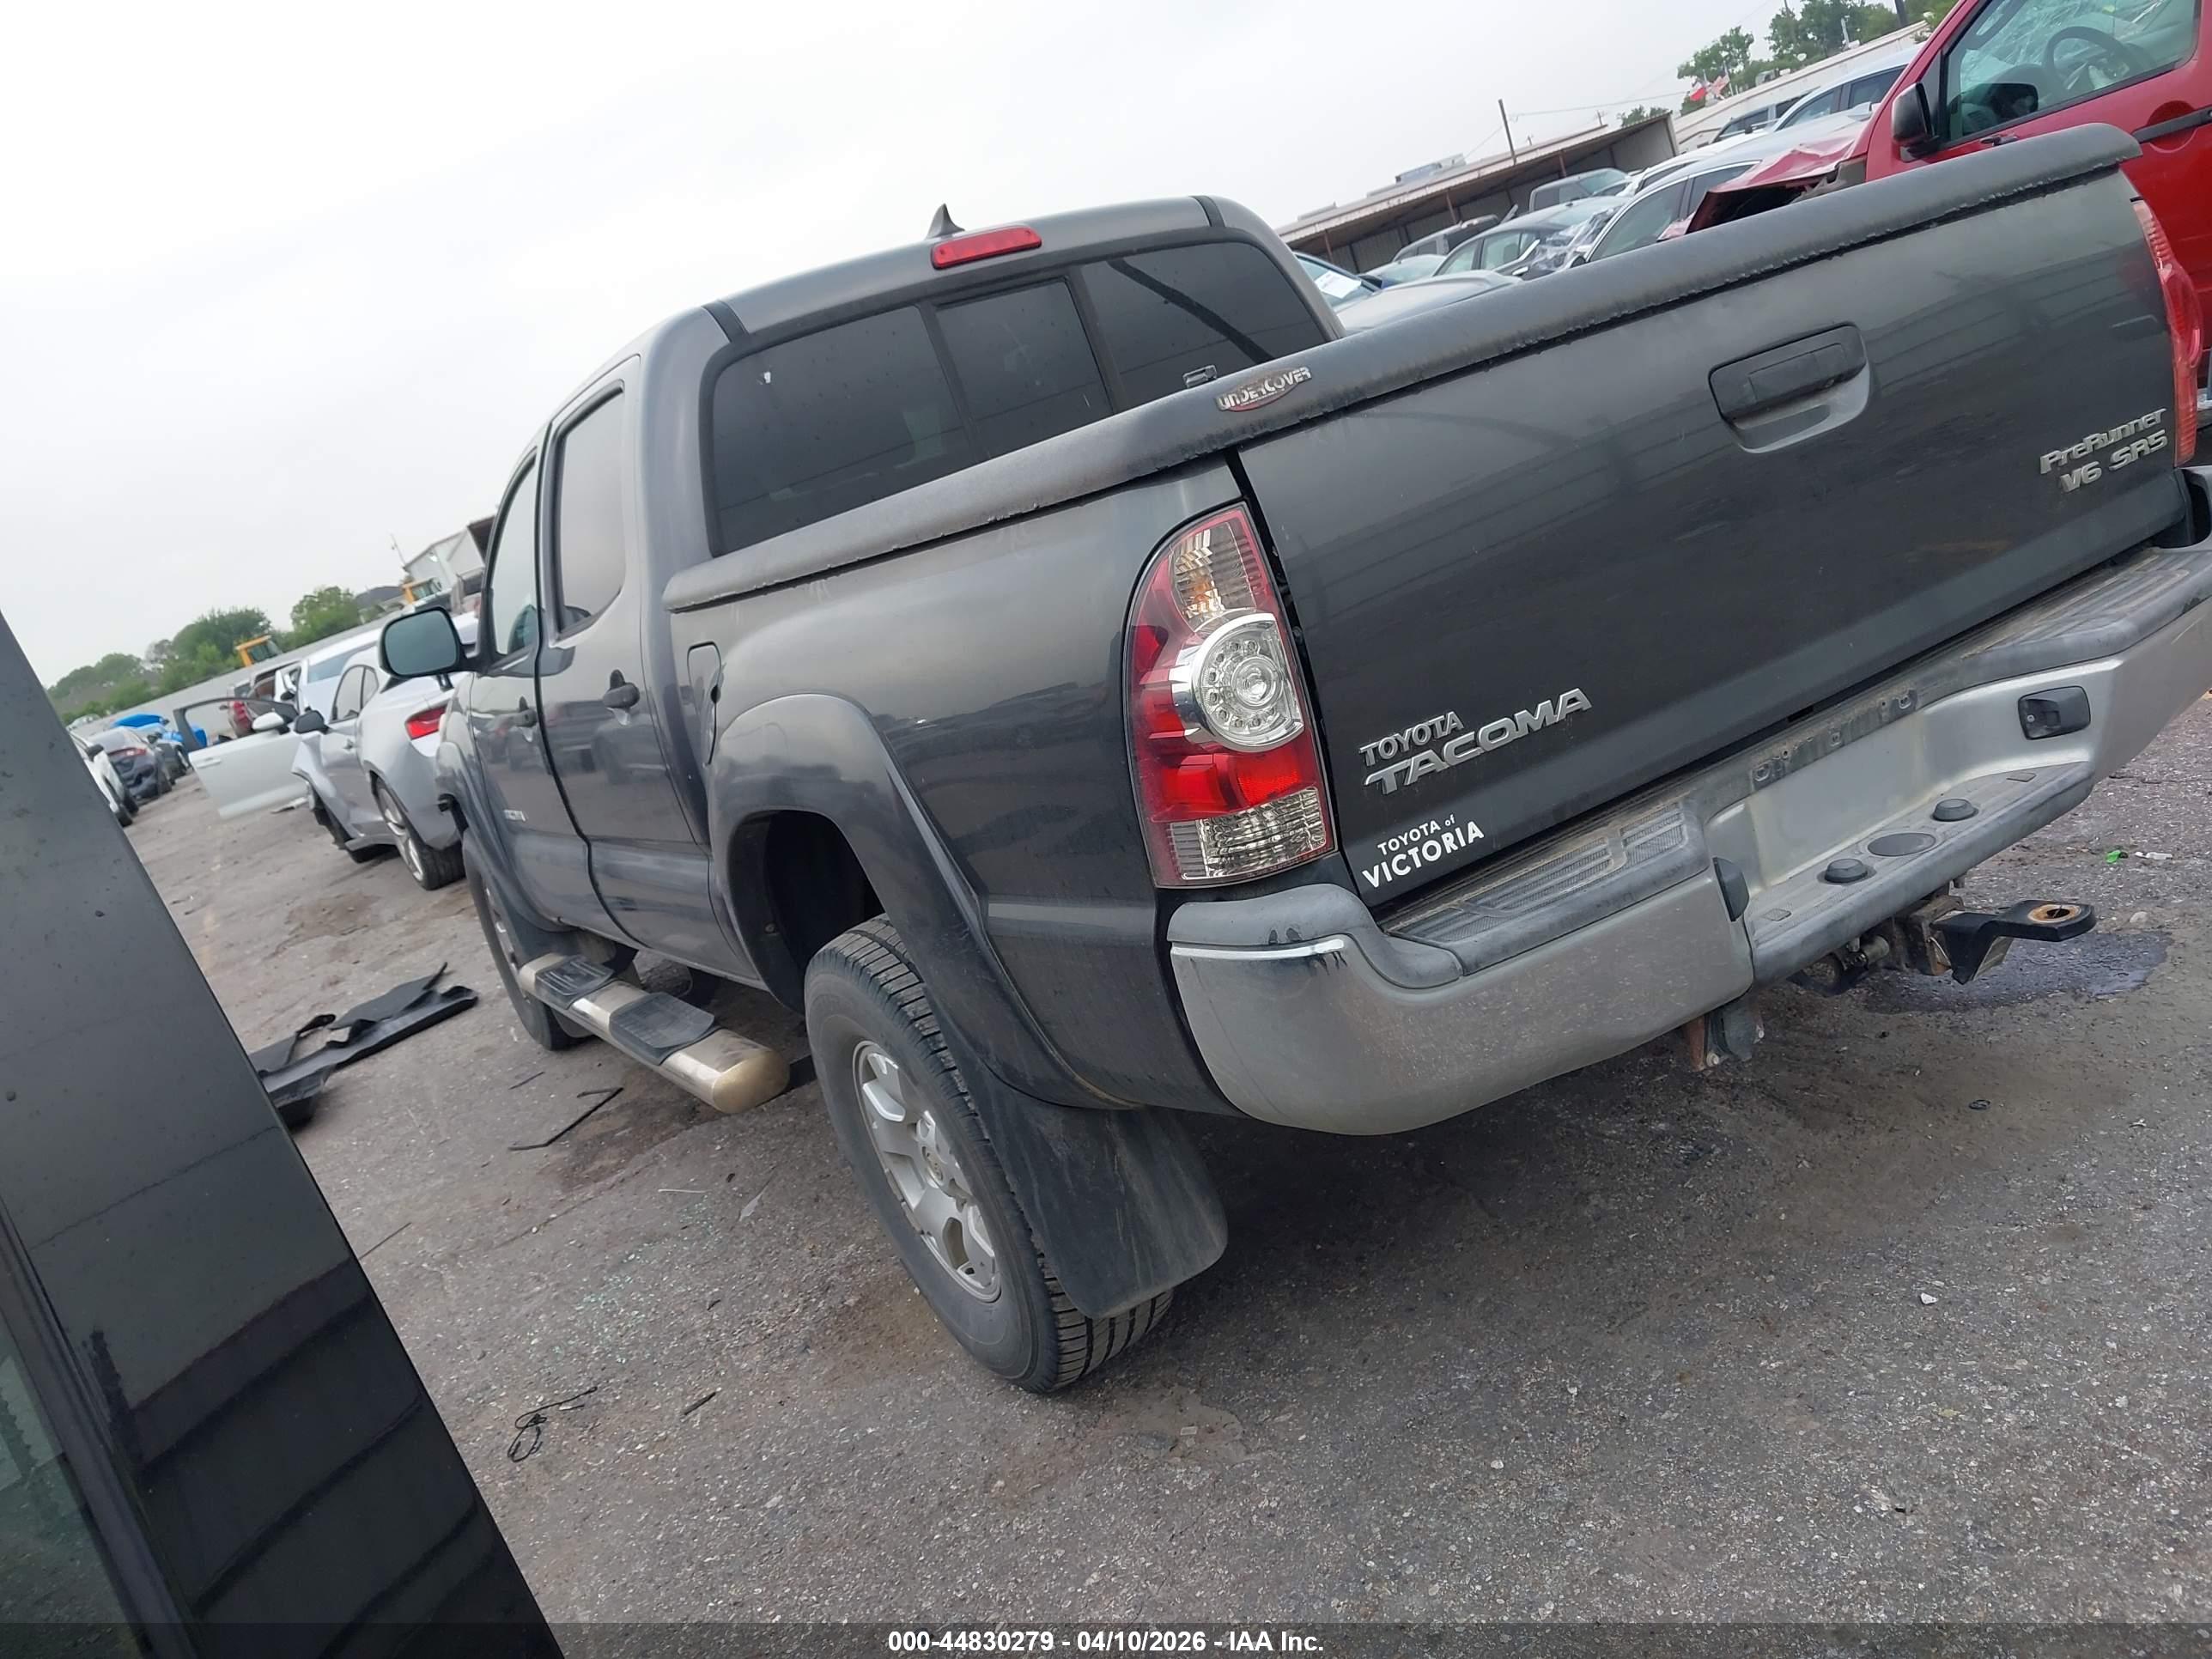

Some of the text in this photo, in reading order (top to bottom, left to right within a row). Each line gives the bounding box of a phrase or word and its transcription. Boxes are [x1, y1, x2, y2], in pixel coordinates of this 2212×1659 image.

[2040, 407, 2167, 474] PreRunner
[2061, 429, 2168, 493] V6 SR5
[1358, 711, 1464, 766] TOYOTA
[1364, 688, 1592, 794] TACOMA
[1362, 821, 1485, 888] VICTORIA
[1377, 814, 1456, 855] TOYOTA of
